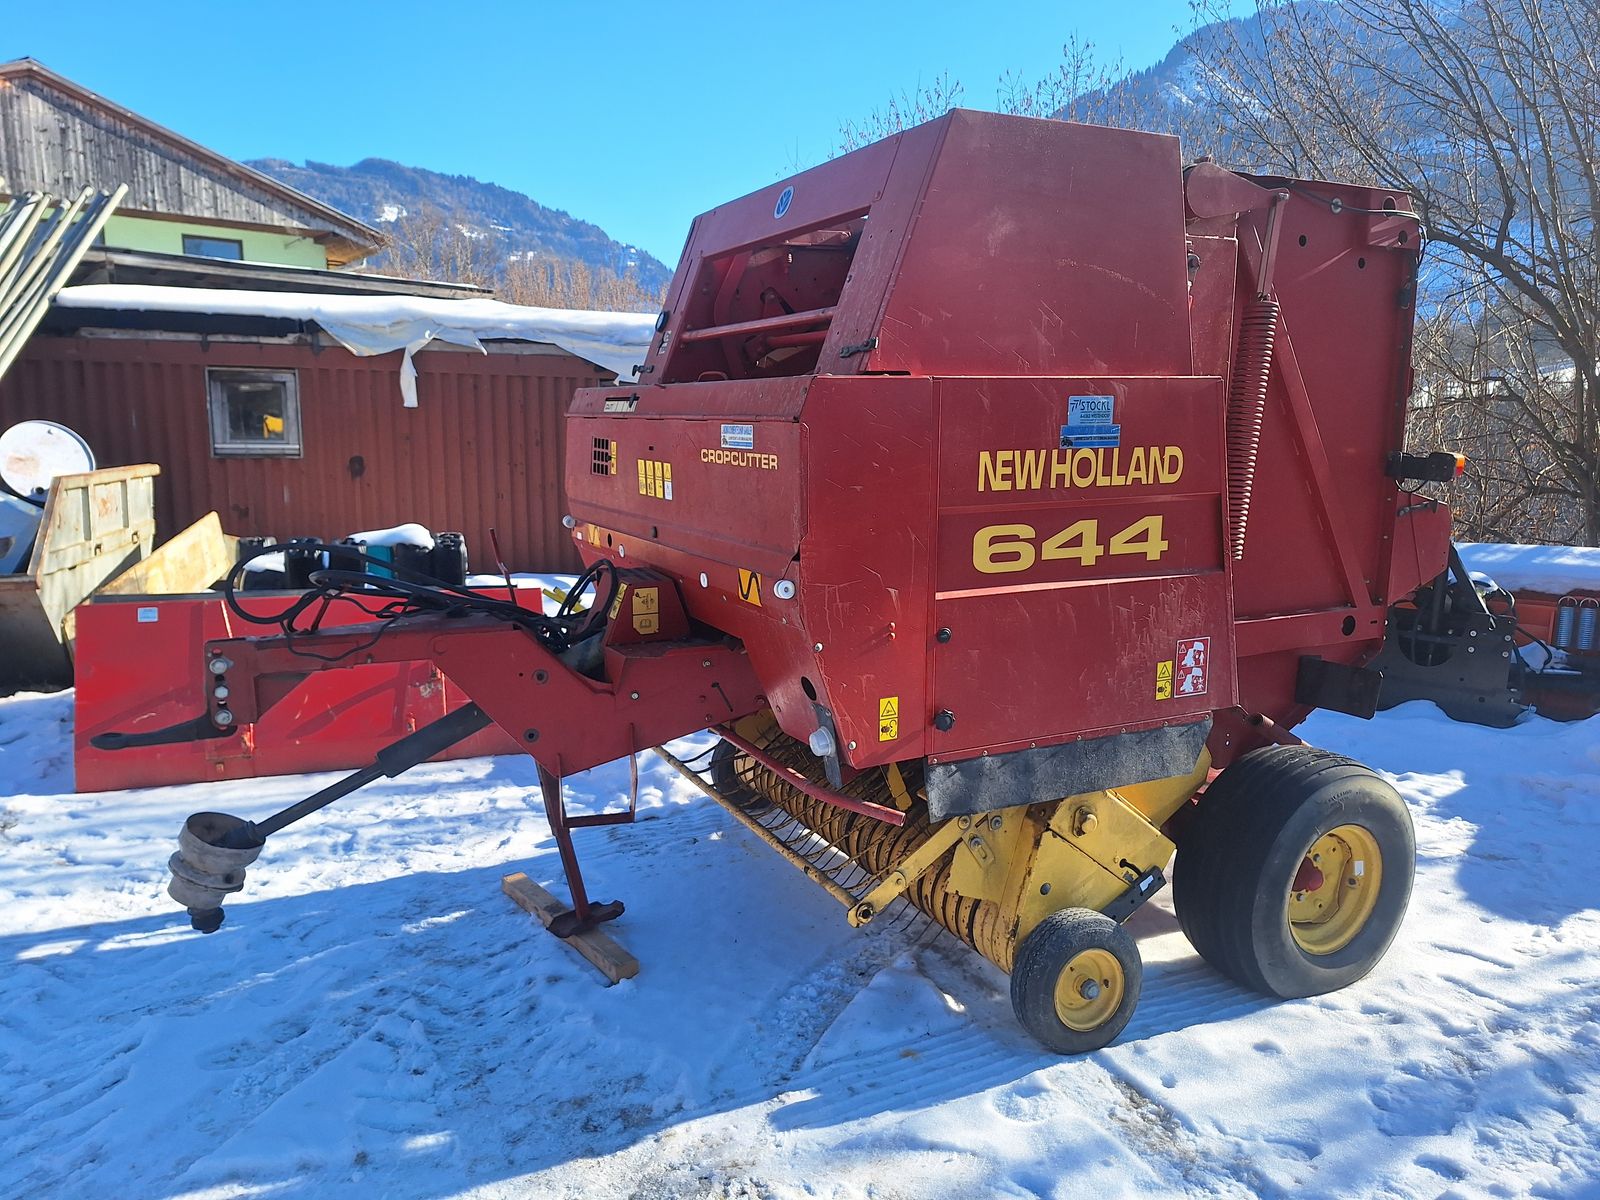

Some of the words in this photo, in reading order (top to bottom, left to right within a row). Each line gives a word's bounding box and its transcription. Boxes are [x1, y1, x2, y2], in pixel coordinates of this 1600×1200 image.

[700, 448, 778, 470] CROPCUTTER
[977, 448, 1047, 492] NEW
[1050, 445, 1184, 489] HOLLAND
[972, 514, 1169, 575] 644
